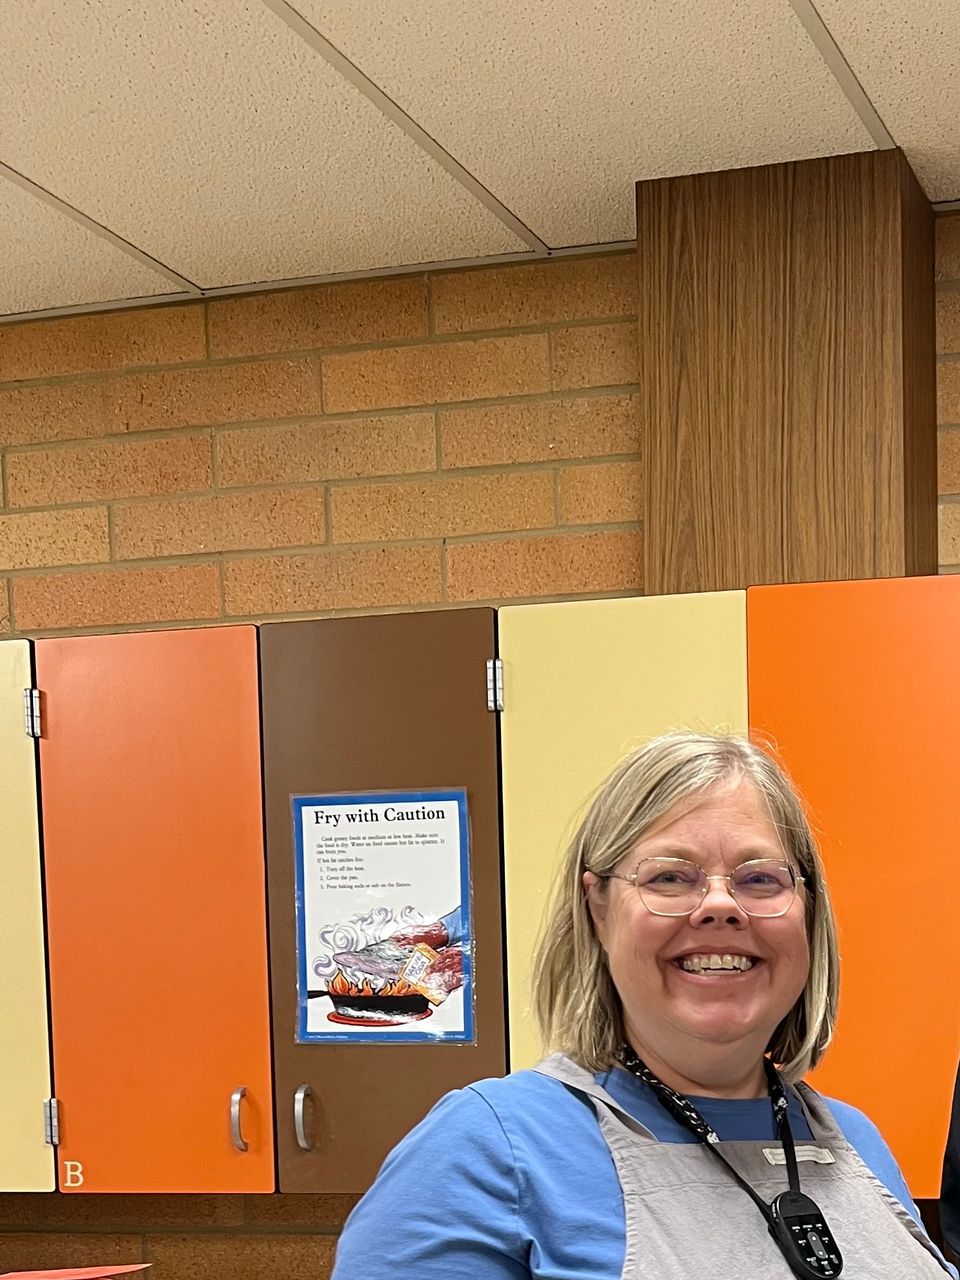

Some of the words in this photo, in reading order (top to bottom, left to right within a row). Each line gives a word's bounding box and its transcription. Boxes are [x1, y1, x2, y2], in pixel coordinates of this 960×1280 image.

[314, 811, 341, 827] Fry
[346, 809, 379, 823] with
[384, 806, 445, 821] Caution
[64, 1161, 84, 1187] B
